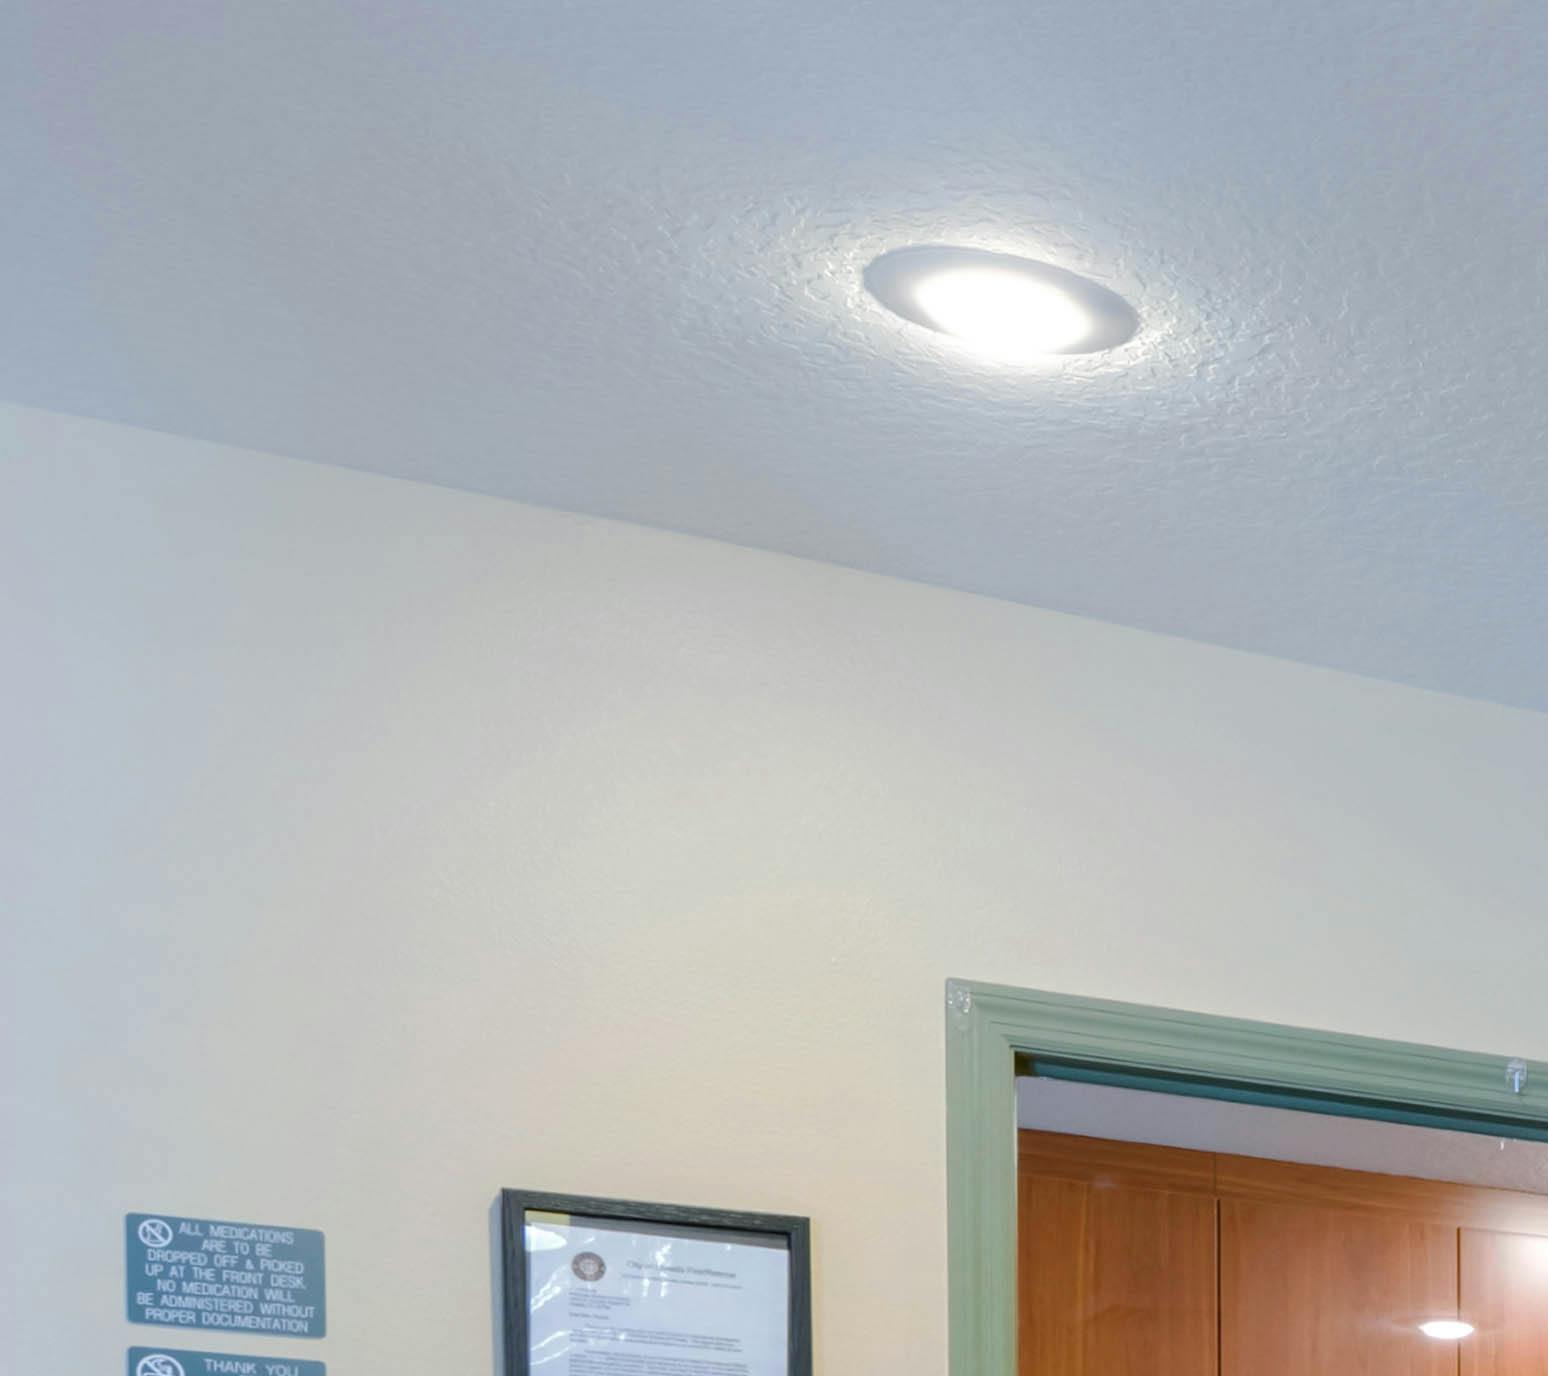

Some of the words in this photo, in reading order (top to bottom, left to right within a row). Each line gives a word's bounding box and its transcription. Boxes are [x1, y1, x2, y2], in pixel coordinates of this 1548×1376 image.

[179, 1222, 204, 1236] ALL
[210, 1225, 294, 1245] MEDICATIONS
[202, 1240, 226, 1253] ARE
[233, 1243, 249, 1255] TO
[148, 1248, 208, 1266] DROPPED
[260, 1258, 304, 1274] PICKED
[145, 1264, 164, 1276] UP
[169, 1266, 184, 1278] AT
[194, 1267, 216, 1281] THE
[222, 1270, 262, 1285] FRONT
[156, 1278, 176, 1292] NO
[182, 1281, 258, 1299] MEDICATION
[160, 1294, 254, 1314] ADMINISTERED
[260, 1303, 316, 1318] WITHOUT
[145, 1308, 196, 1324] PROPER
[202, 1312, 309, 1333] DOCUMENTATION
[204, 1358, 257, 1374] THANK
